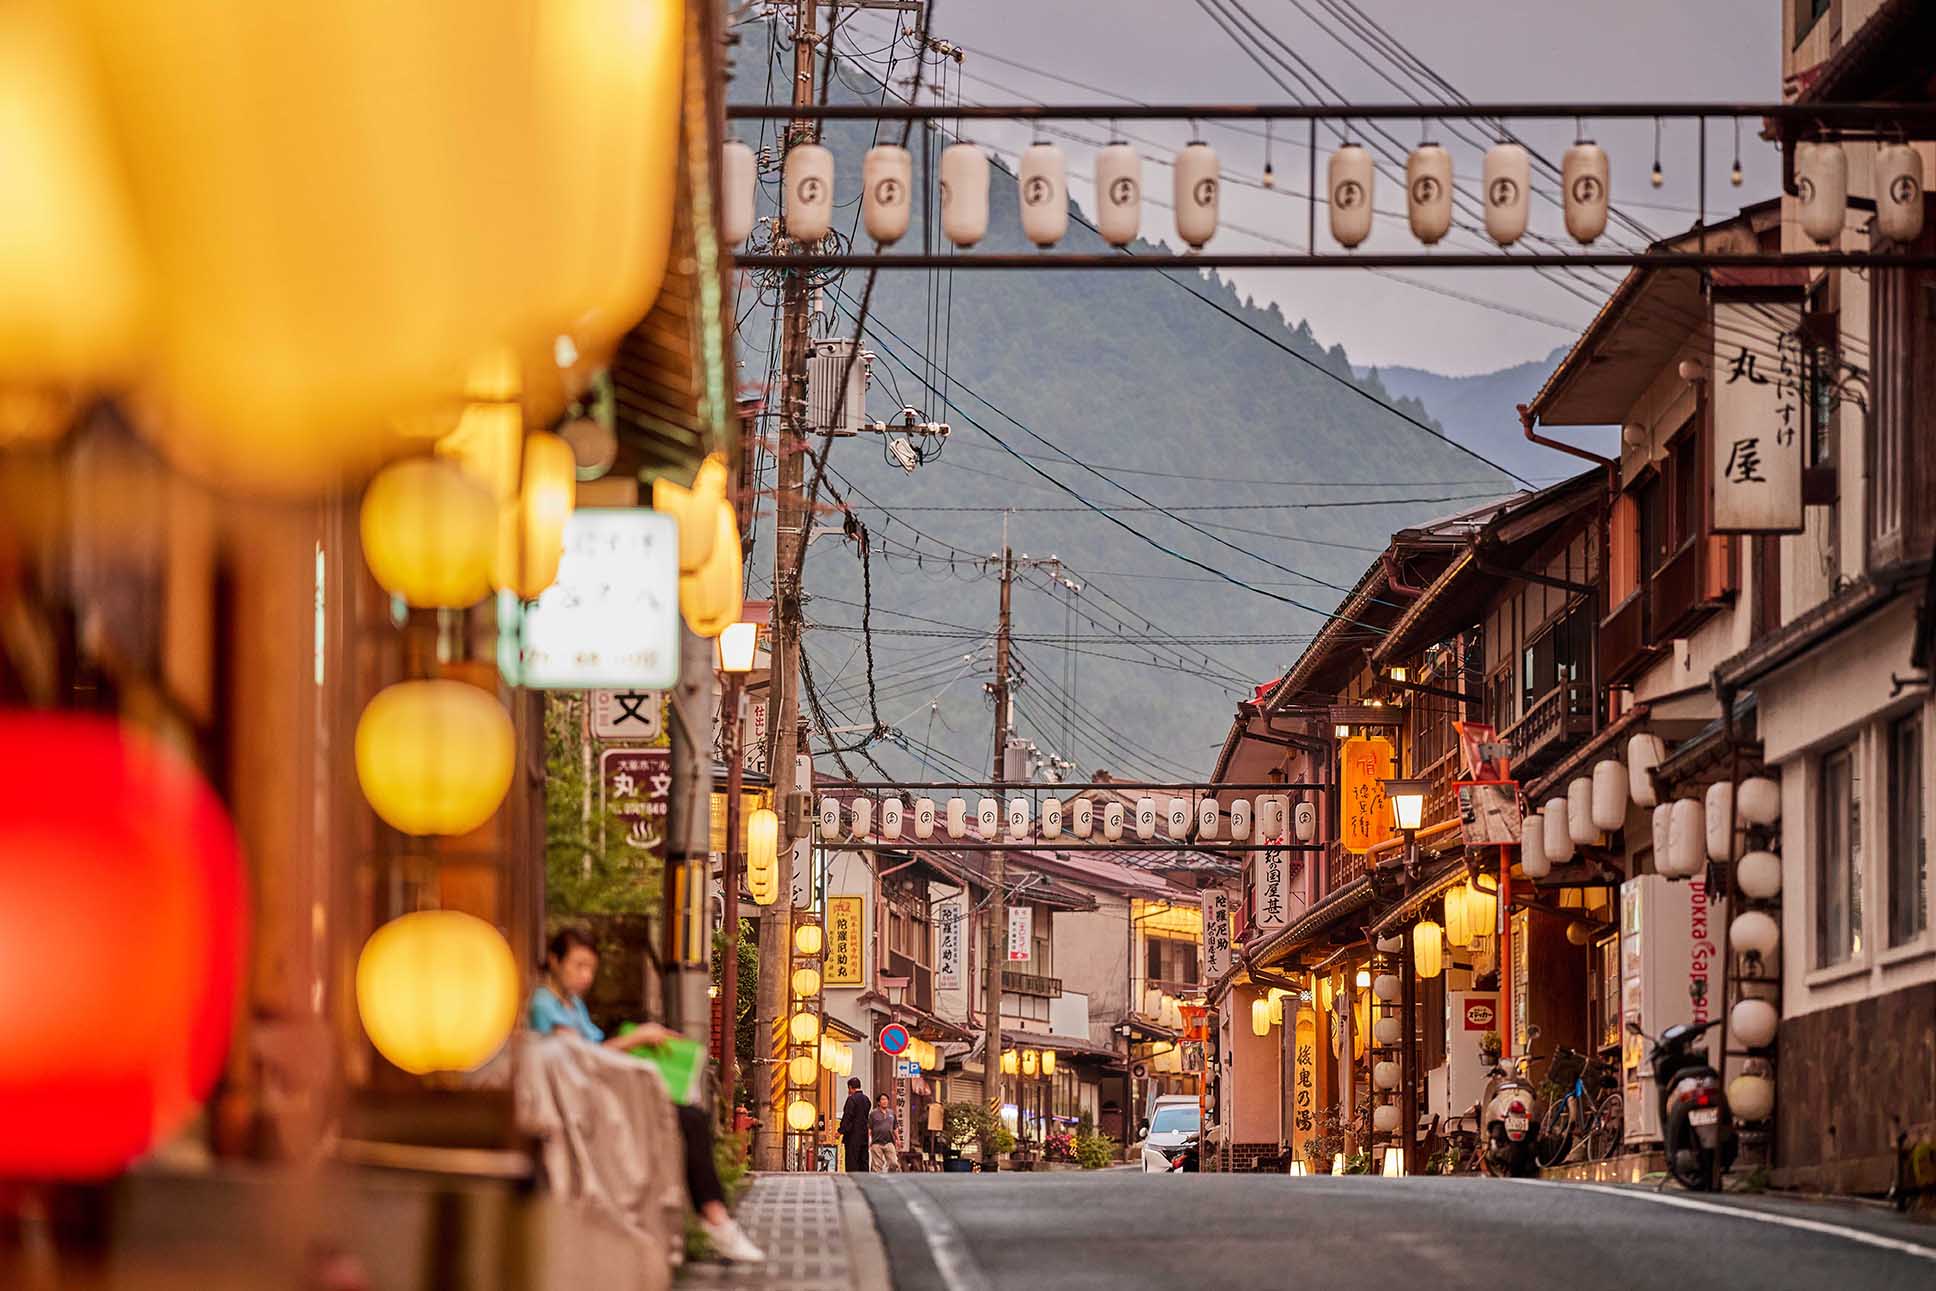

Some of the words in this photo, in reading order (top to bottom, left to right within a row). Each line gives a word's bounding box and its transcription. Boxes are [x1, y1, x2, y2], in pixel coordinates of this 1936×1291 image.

[1724, 346, 1768, 485] 丸屋
[613, 689, 650, 725] 文
[754, 705, 766, 737] 仕出し
[1688, 881, 1708, 940] pokka
[911, 1064, 918, 1073] P
